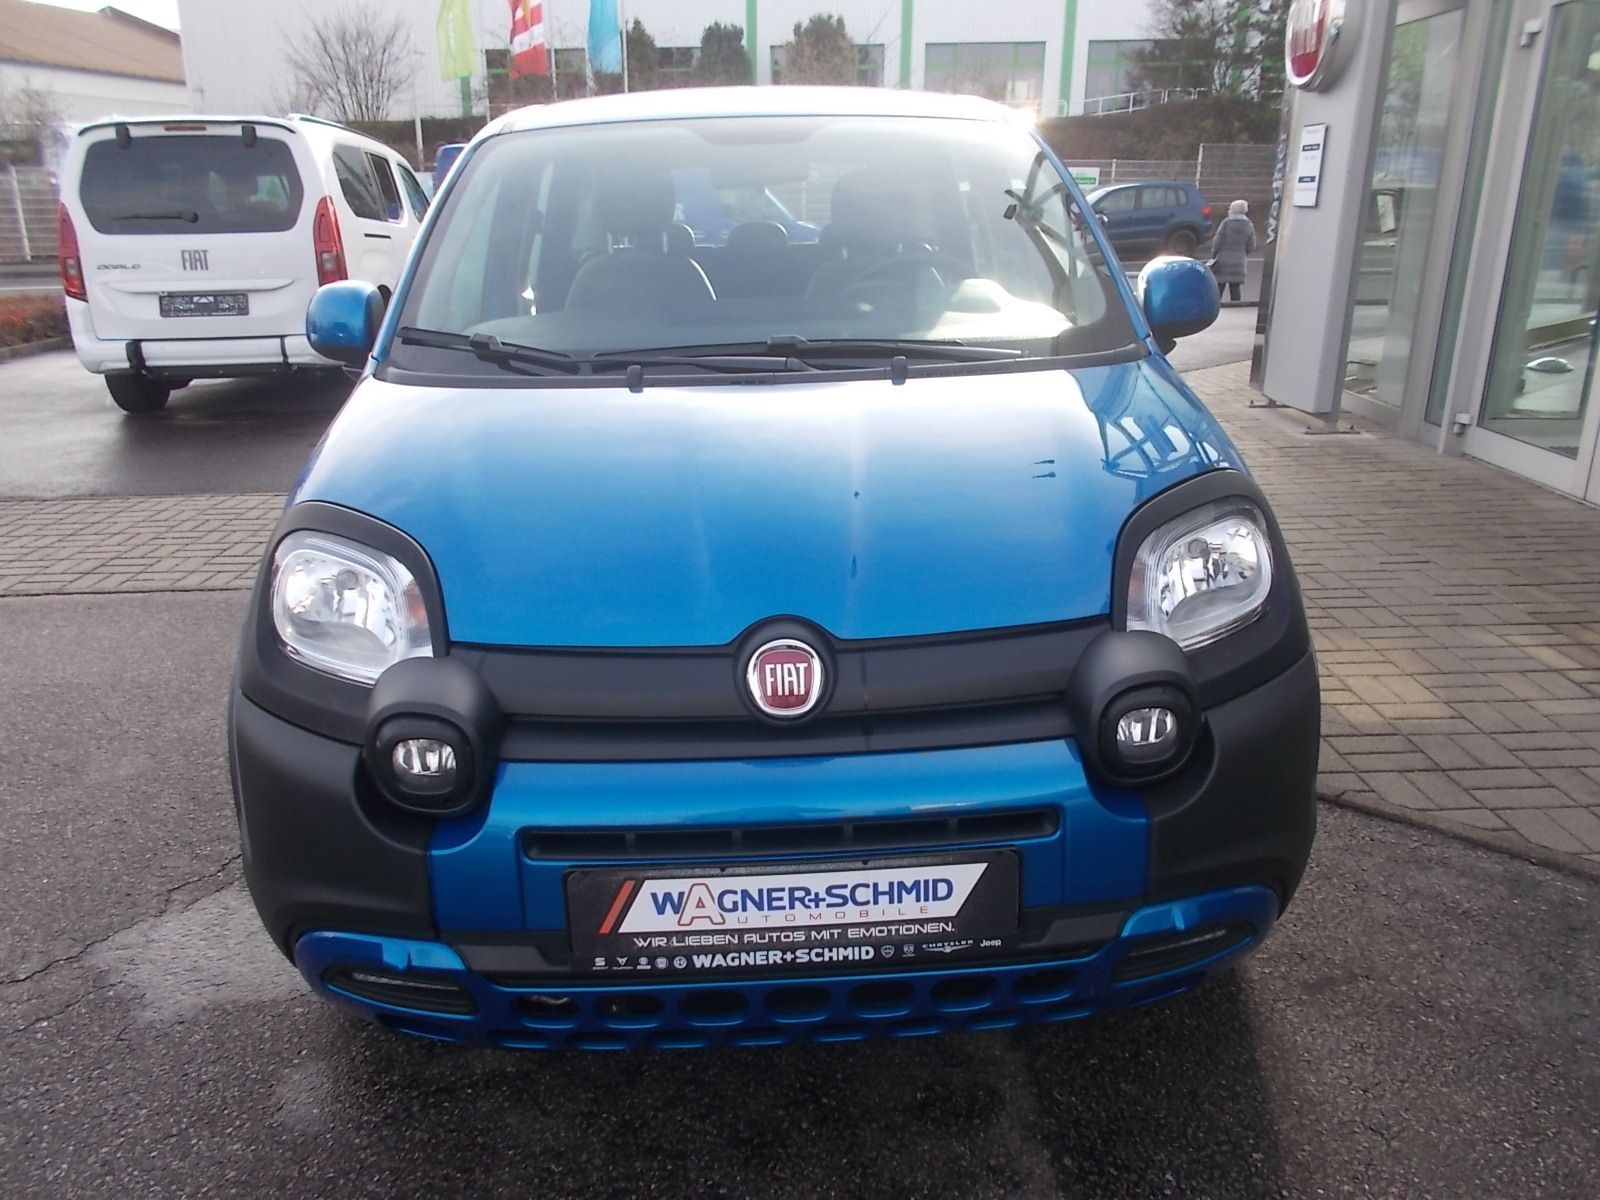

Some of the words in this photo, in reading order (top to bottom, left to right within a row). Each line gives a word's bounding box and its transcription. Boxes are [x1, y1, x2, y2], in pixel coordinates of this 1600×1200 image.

[181, 249, 209, 271] FIAT
[765, 662, 809, 697] FIAT
[650, 877, 954, 927] WAGNER+SCHMID
[633, 936, 667, 948] WIR
[673, 933, 739, 947] LIEBEN
[743, 931, 805, 944] AUTOS
[811, 928, 842, 941] MIT
[848, 921, 955, 939] EMOTIONEN.
[979, 938, 1002, 948] Jeep
[691, 945, 875, 969] WAGNER+SCHMID
